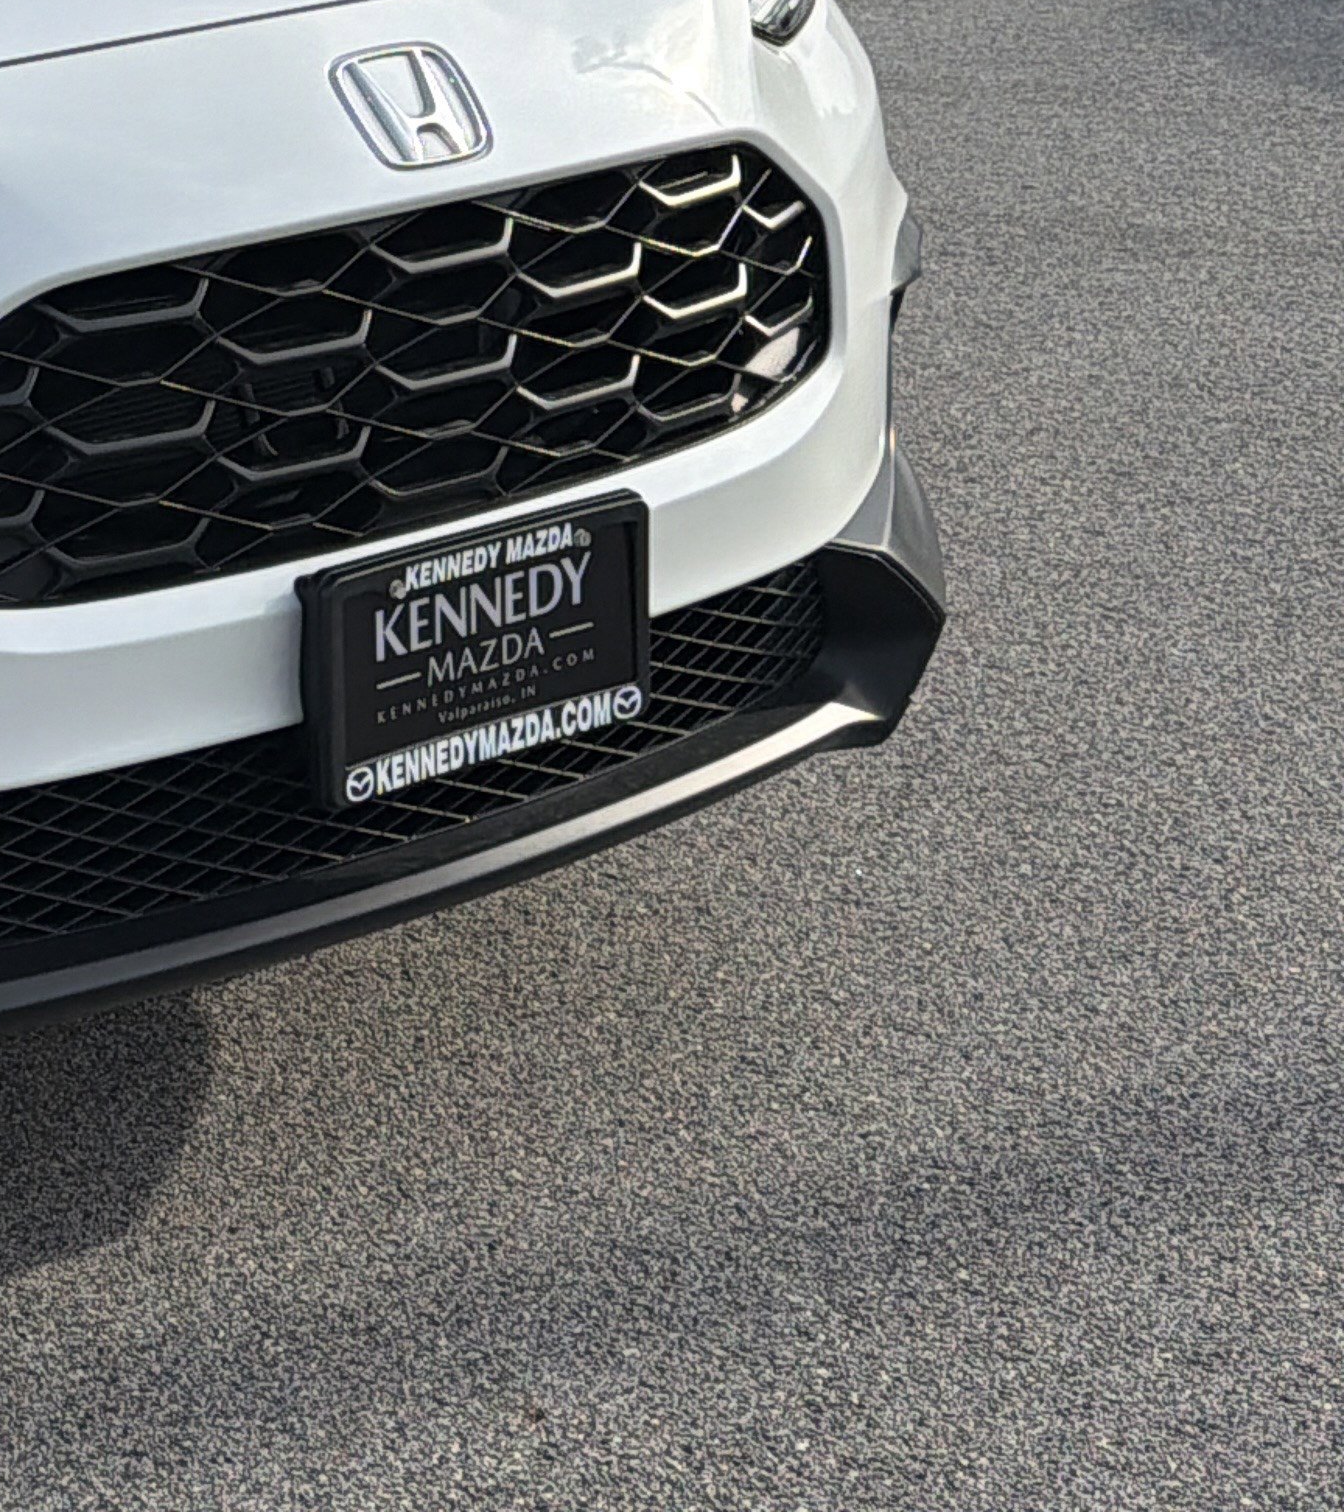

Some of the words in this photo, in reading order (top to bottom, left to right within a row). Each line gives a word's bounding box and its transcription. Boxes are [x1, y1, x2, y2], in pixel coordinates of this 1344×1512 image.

[404, 541, 501, 592] KENNEDY
[505, 522, 574, 565] MAZDA
[375, 550, 592, 663] KENNEDY
[376, 648, 595, 724] KENNEDYMAZDA.COM
[427, 626, 546, 687] MAZDA
[520, 685, 537, 699] IN
[375, 691, 613, 795] KENNEDYMAZDA.COM
